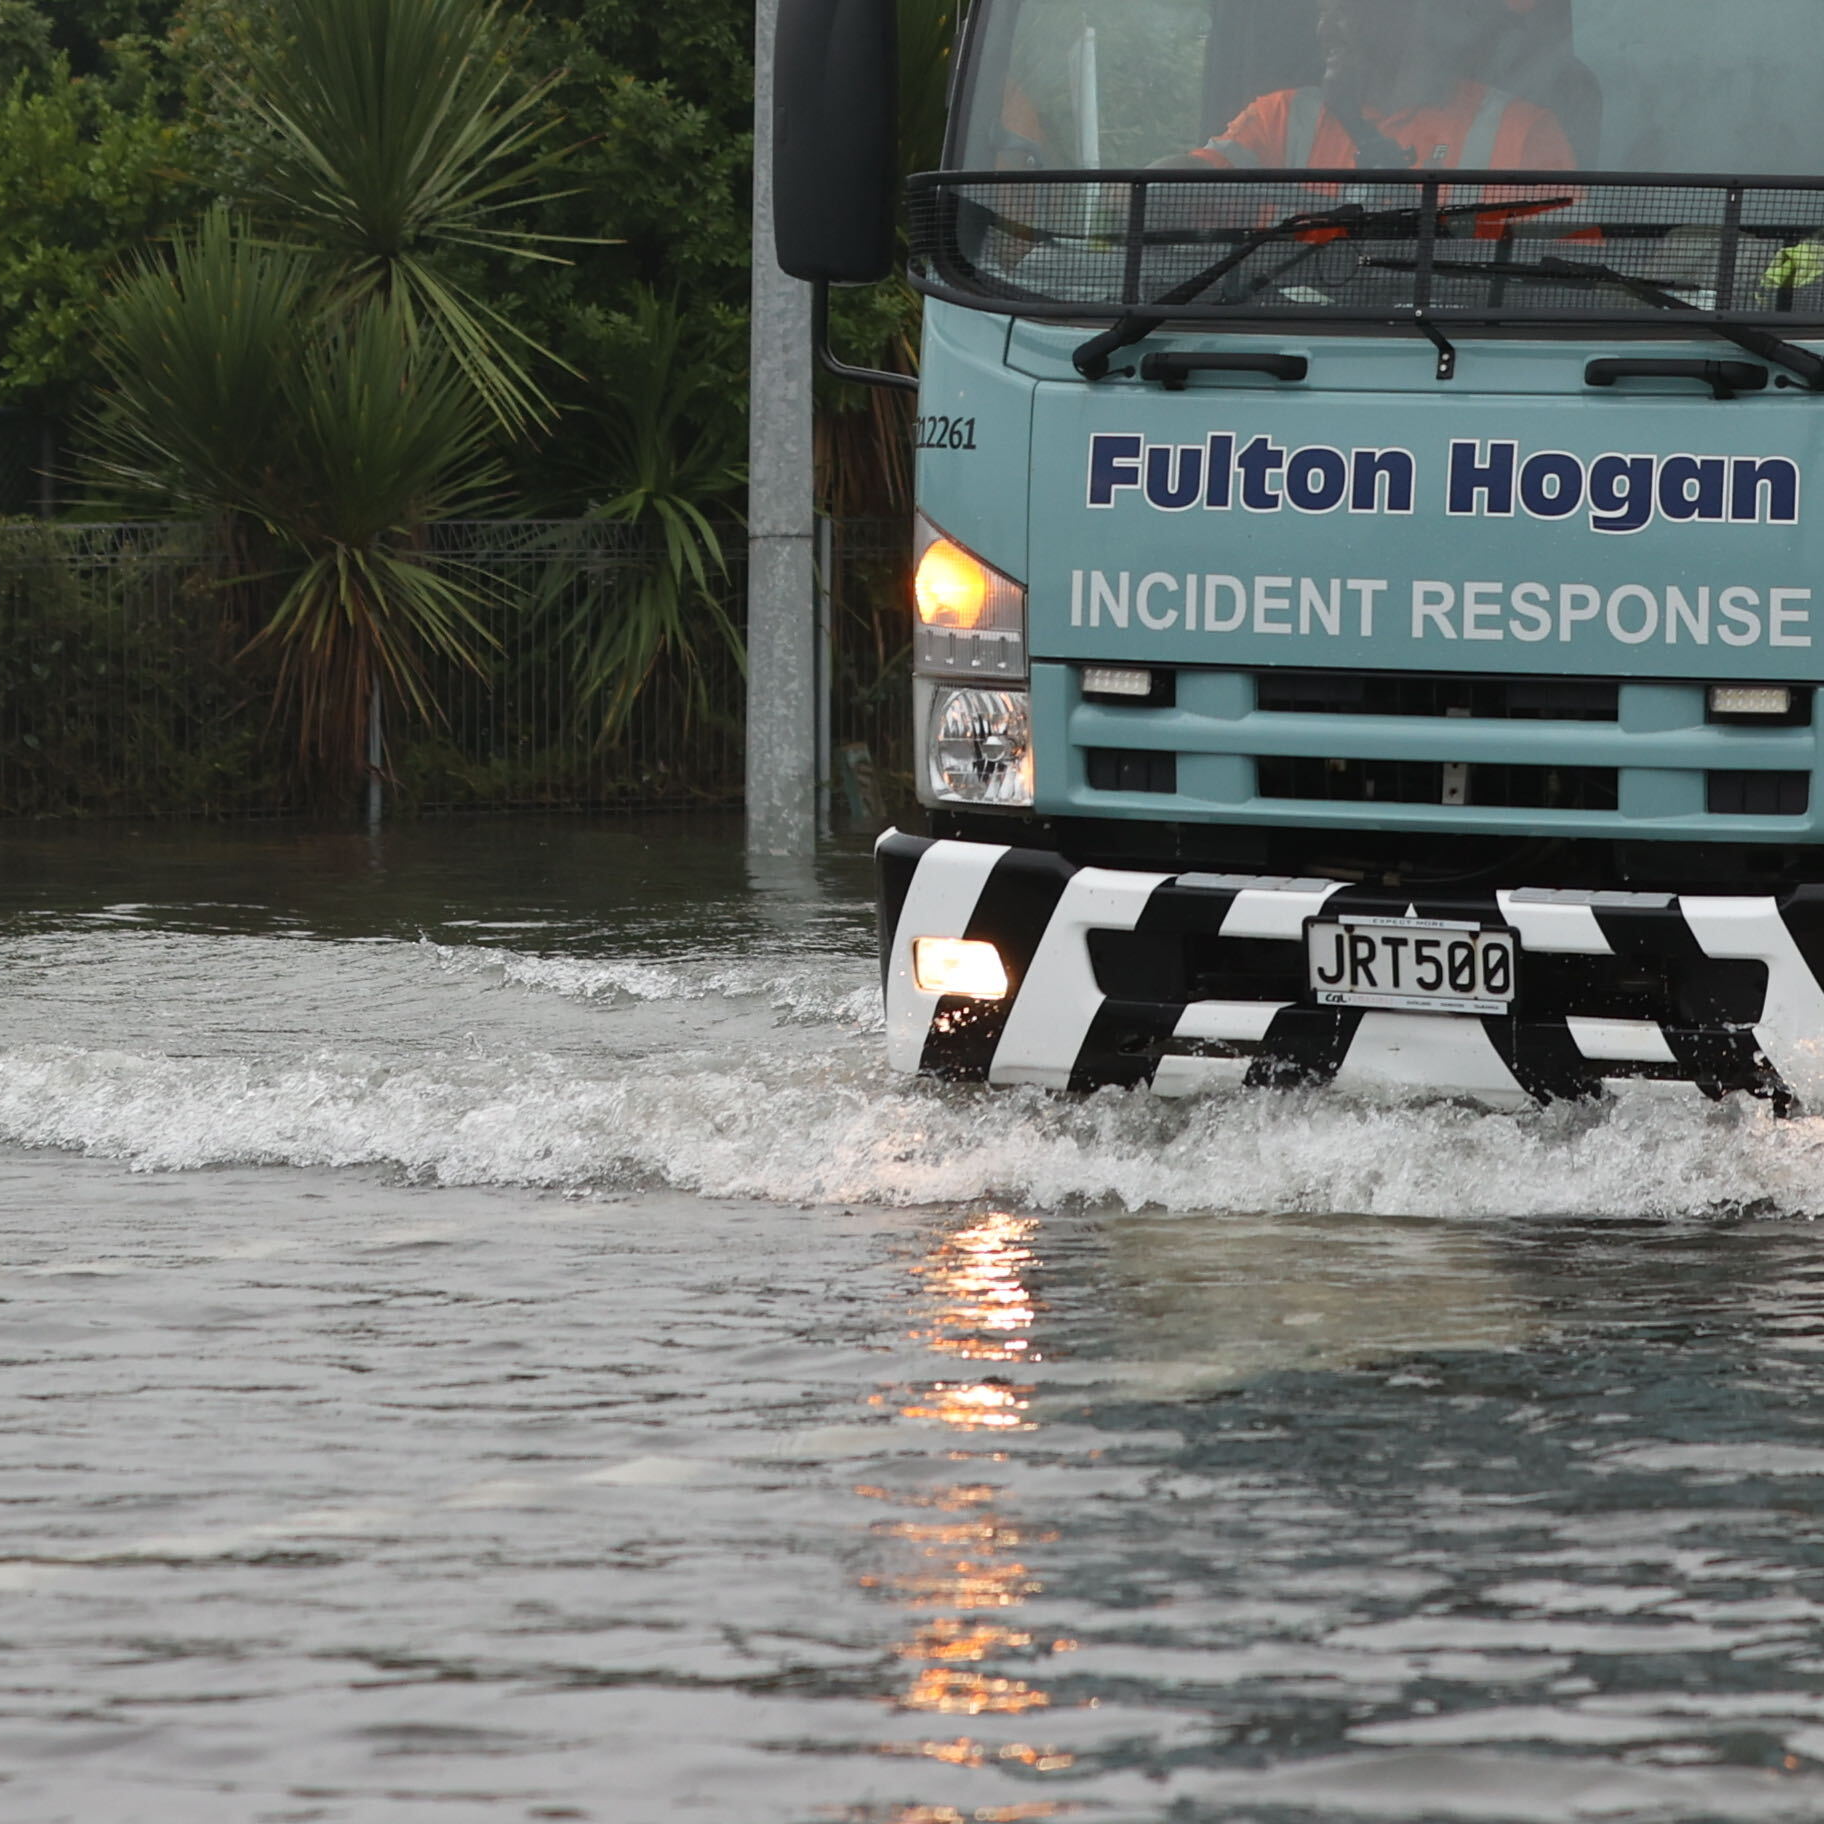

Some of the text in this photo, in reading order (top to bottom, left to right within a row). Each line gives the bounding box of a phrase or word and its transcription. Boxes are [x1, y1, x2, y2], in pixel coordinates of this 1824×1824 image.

[1086, 431, 1801, 536] Fulton Hogan
[1071, 570, 1813, 648] INCIDENT RESPONSE
[1317, 933, 1511, 995] JRT500
